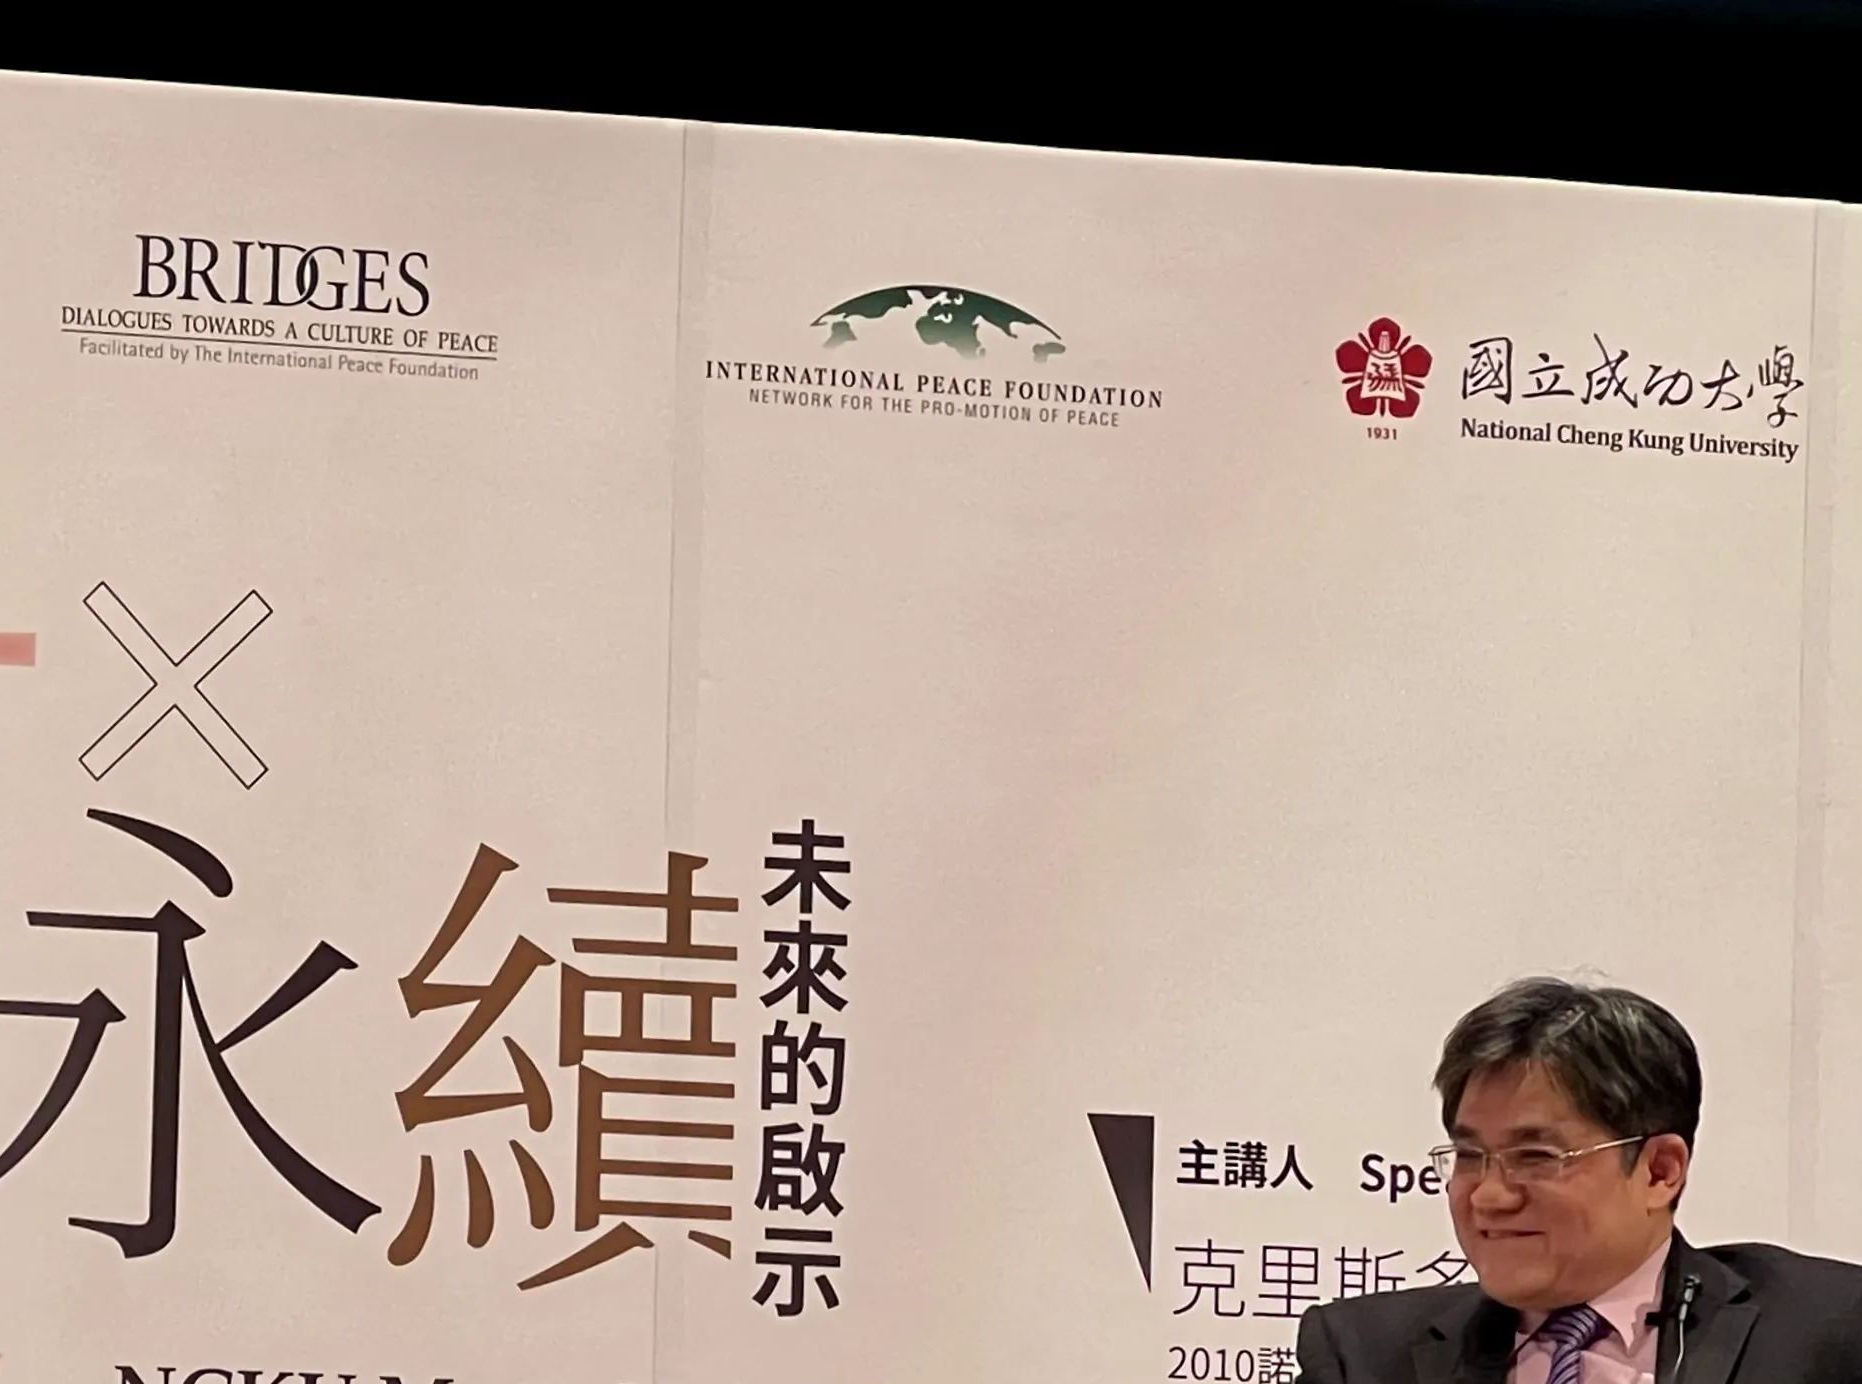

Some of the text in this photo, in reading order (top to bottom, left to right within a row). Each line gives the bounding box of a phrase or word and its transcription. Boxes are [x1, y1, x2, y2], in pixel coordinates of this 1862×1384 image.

[133, 234, 429, 317] BRIDGES
[62, 306, 498, 353] DIALOGUES TOWARDS A CULTURE OF PEACE
[80, 337, 478, 380] Facilitated by The International Peace Foundation
[706, 360, 1162, 408] INTERNATIONAL PEACE FOUNDATION
[750, 388, 1119, 427] NETWORK FOR THE PRO-MOTION OF PEACE
[1367, 427, 1397, 440] 1931
[1461, 418, 1799, 463] National Cheng Kung University
[752, 819, 851, 1317] 未來的啟示
[1177, 1139, 1314, 1190] 主講人
[1360, 1153, 1450, 1204] Spe
